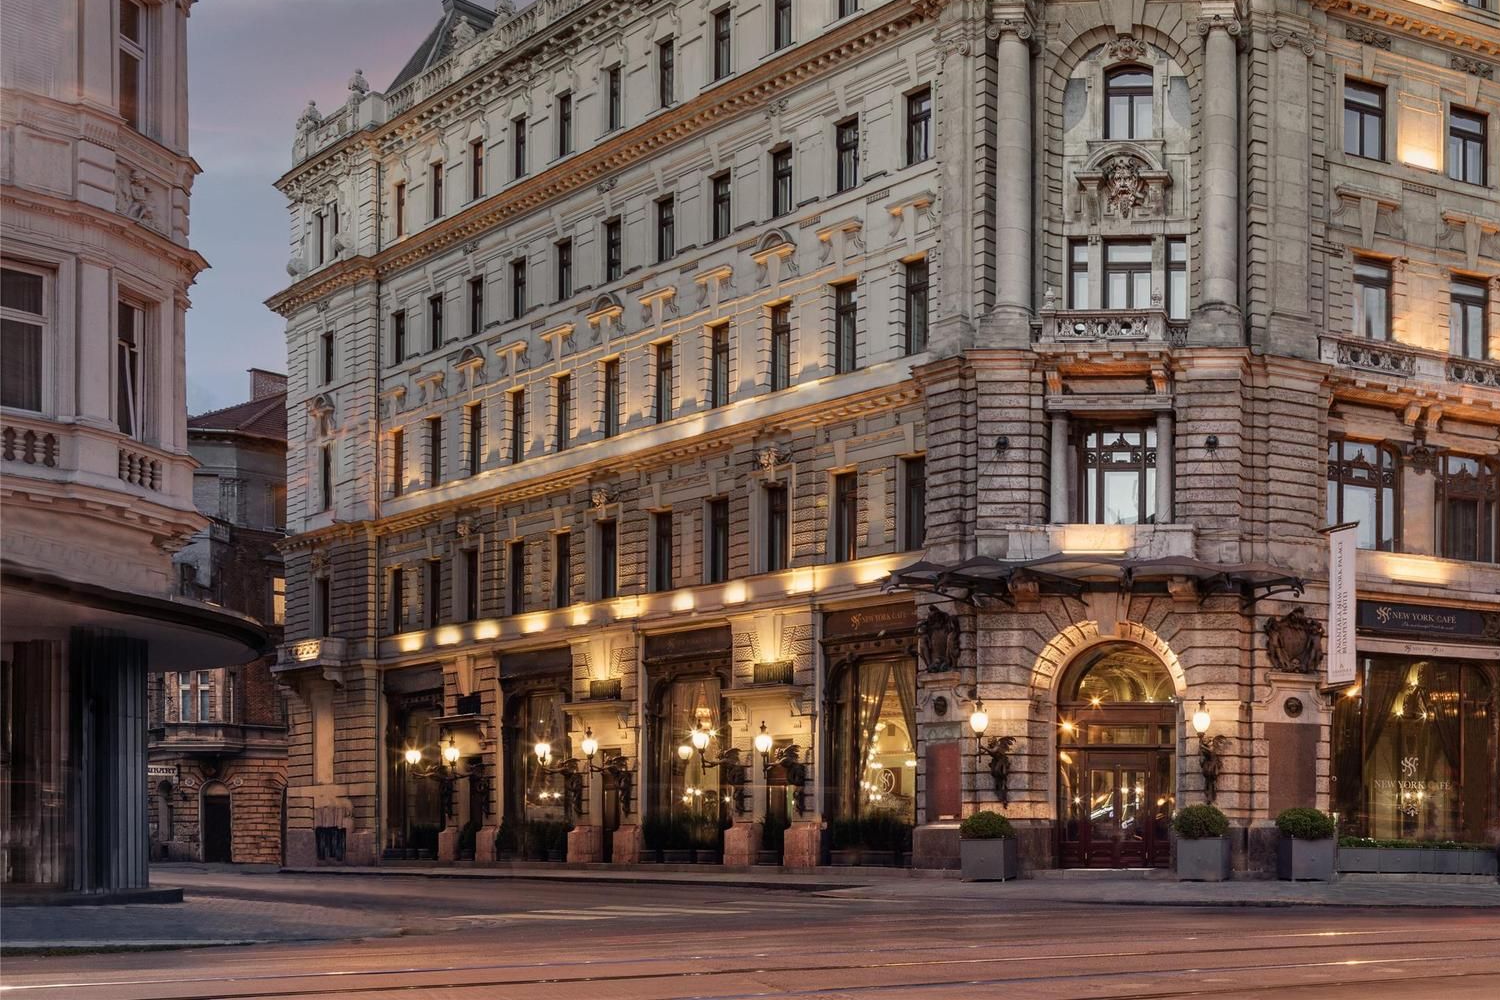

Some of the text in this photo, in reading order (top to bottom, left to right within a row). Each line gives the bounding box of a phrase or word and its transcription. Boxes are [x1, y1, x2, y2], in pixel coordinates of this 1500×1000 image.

[1392, 611, 1457, 624] NEW YORK CAFÉ
[1375, 780, 1396, 789] NEW
[1398, 780, 1425, 789] YORK
